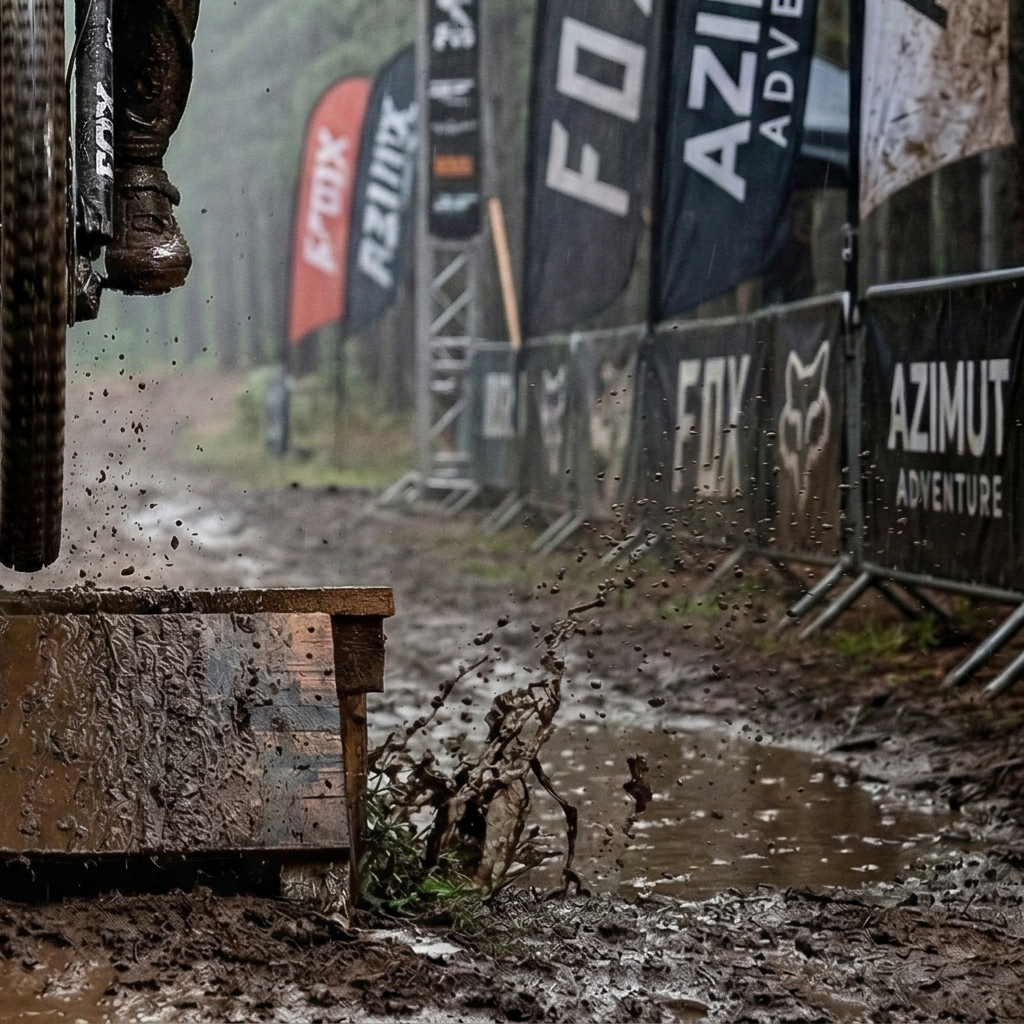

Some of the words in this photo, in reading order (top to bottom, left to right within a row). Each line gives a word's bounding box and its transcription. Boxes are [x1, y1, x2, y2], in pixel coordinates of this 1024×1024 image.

[672, 354, 751, 498] FOX
[887, 358, 1011, 457] AZIMUT
[896, 467, 1003, 518] ADVENTURE
